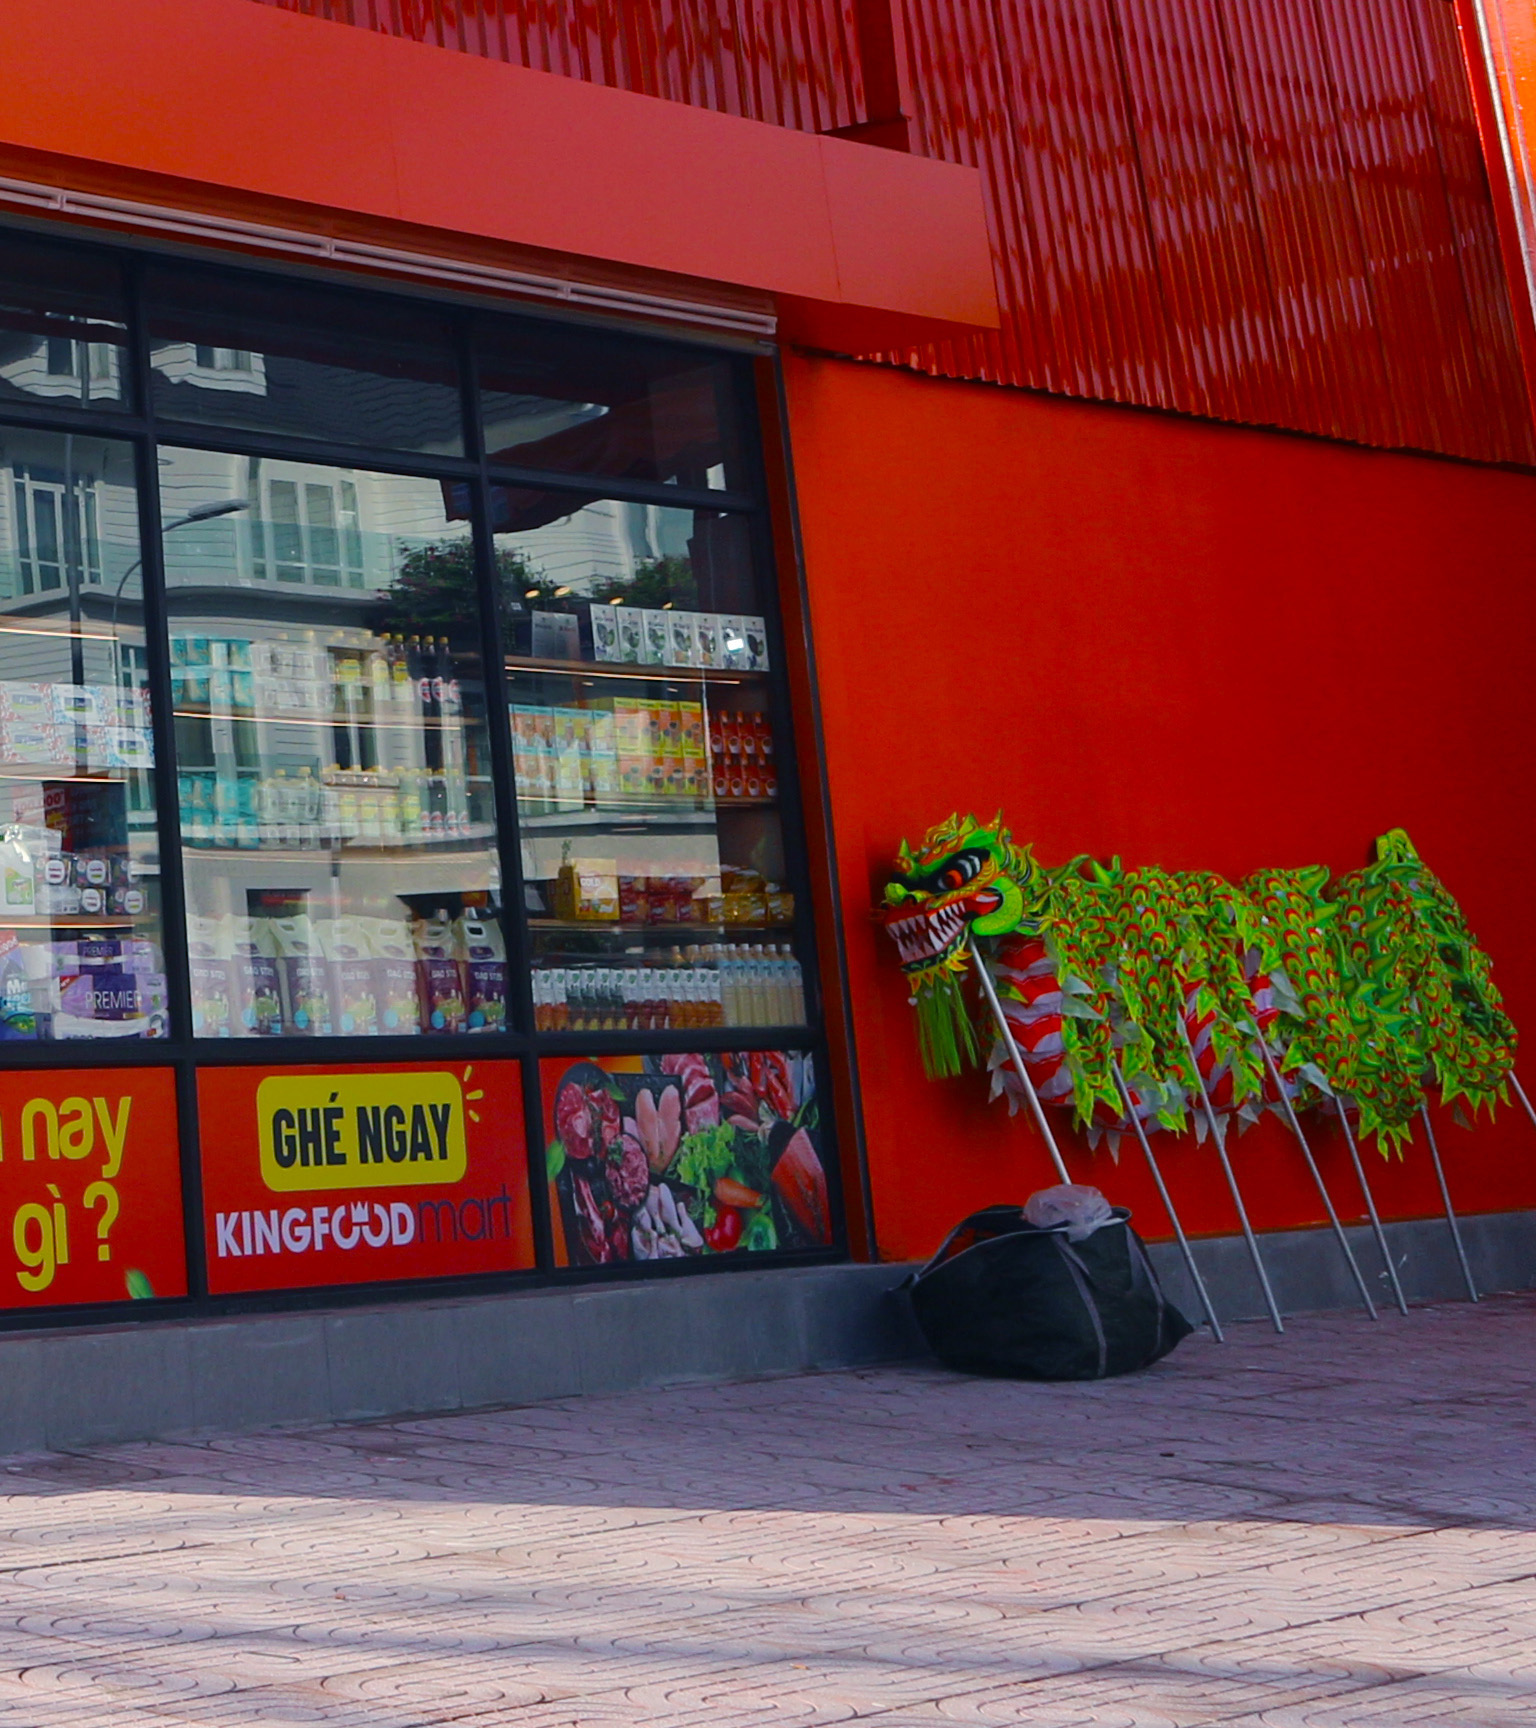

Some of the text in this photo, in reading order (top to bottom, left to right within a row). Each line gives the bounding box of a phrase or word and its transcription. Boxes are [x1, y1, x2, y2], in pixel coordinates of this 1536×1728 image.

[85, 990, 140, 1010] PREMIER
[21, 1092, 132, 1180] nay
[271, 1091, 452, 1169] GHÉ NGAY
[11, 1186, 71, 1294] gì
